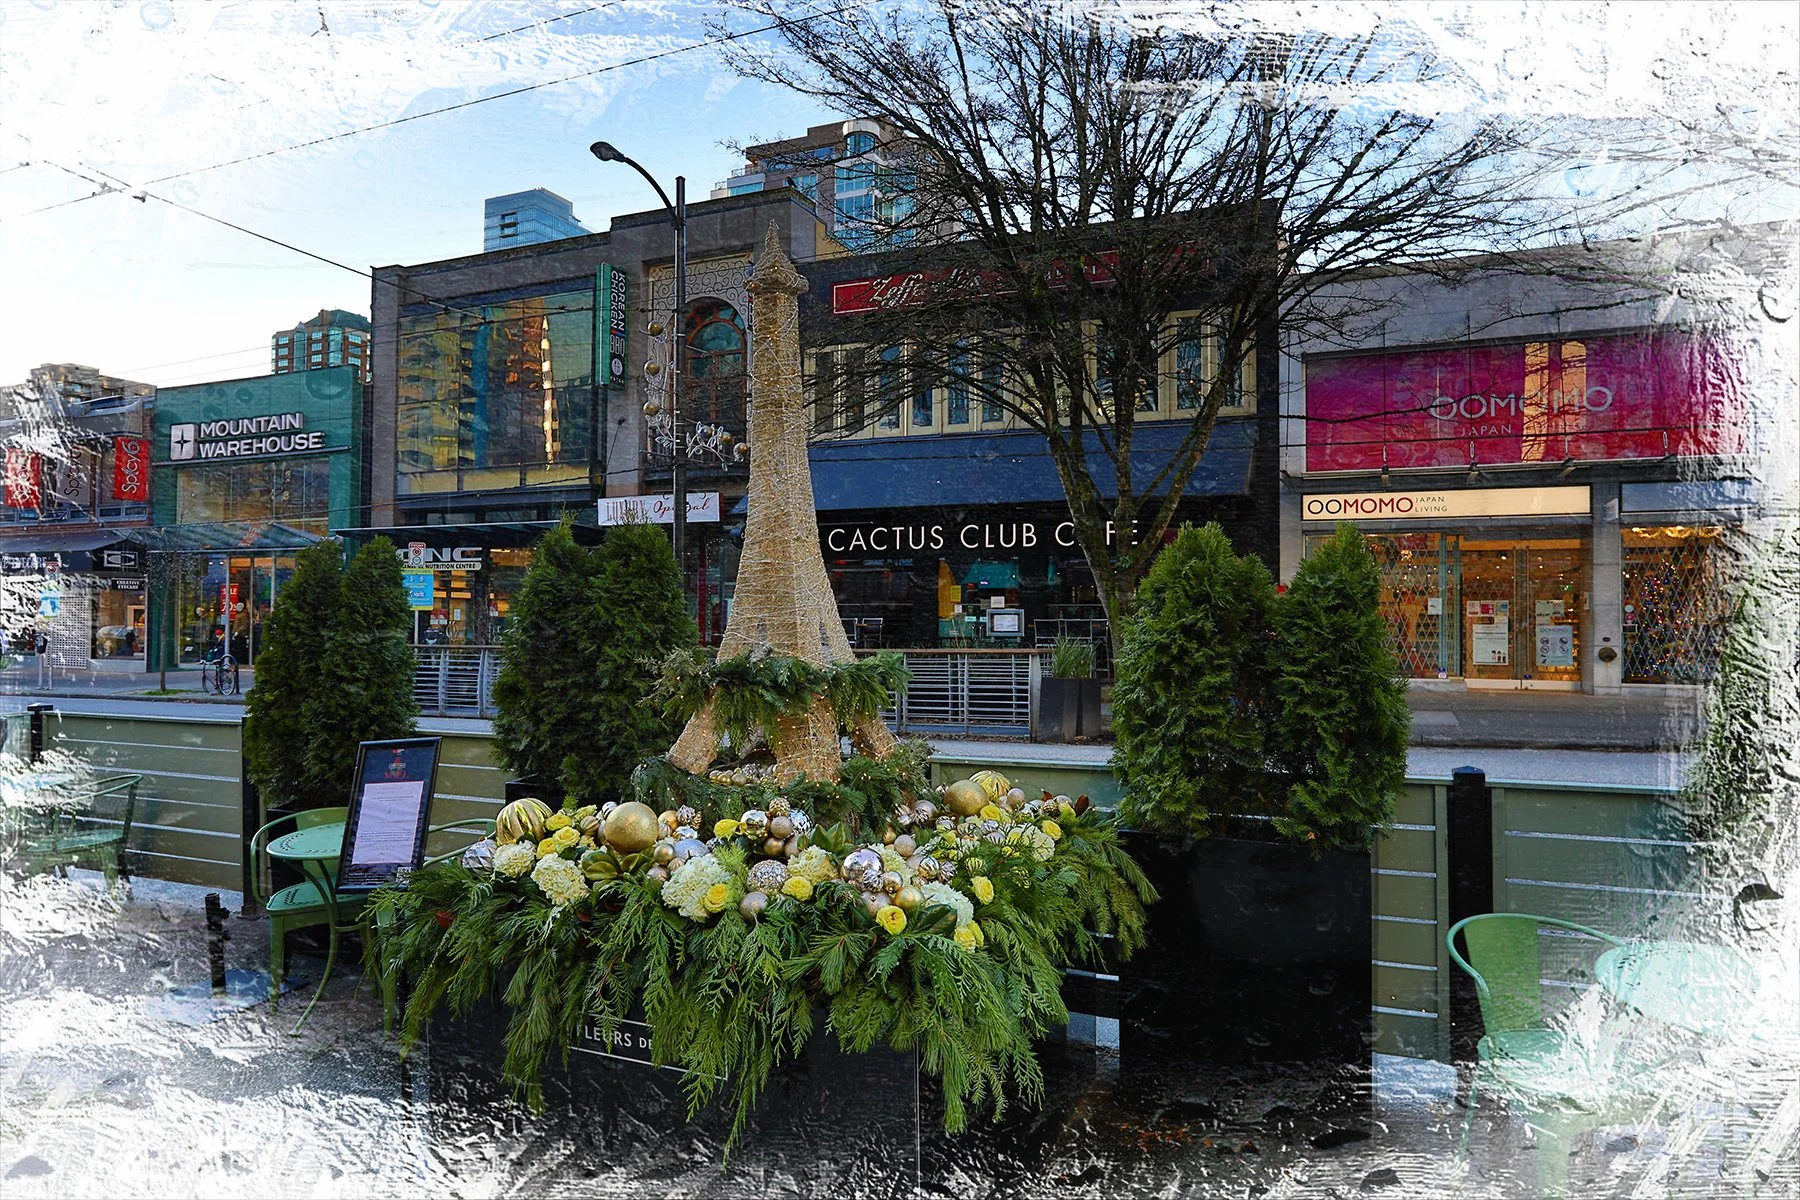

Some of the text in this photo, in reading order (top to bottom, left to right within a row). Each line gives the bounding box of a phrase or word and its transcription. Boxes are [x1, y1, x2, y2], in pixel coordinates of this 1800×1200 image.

[618, 272, 626, 331] KOREAN
[200, 412, 304, 438] MOUNTAIN
[1461, 424, 1512, 437] JAPAN
[199, 432, 325, 458] WAREHOUSE
[121, 440, 141, 493] Spicy6
[1307, 497, 1413, 515] OOMOMO
[828, 520, 1138, 551] CACTUS CLUB CFE
[222, 587, 238, 595] SLE
